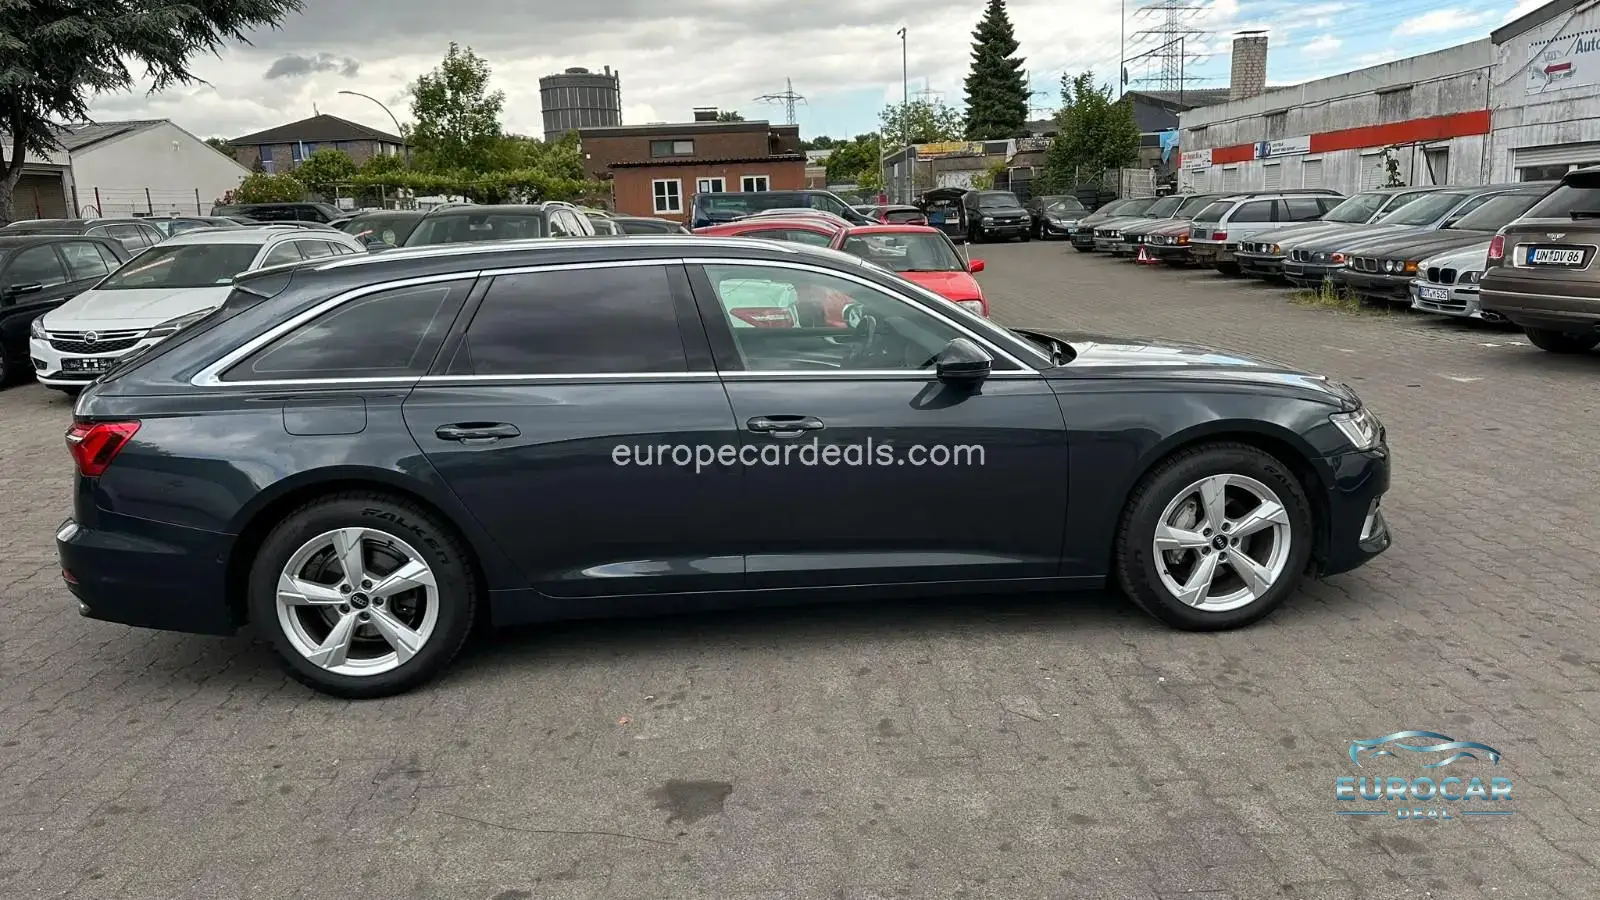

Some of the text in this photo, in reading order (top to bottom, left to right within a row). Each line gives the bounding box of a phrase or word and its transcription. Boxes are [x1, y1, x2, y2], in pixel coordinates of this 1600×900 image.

[1536, 250, 1579, 262] UN DV 86
[361, 508, 449, 564] FALKEN
